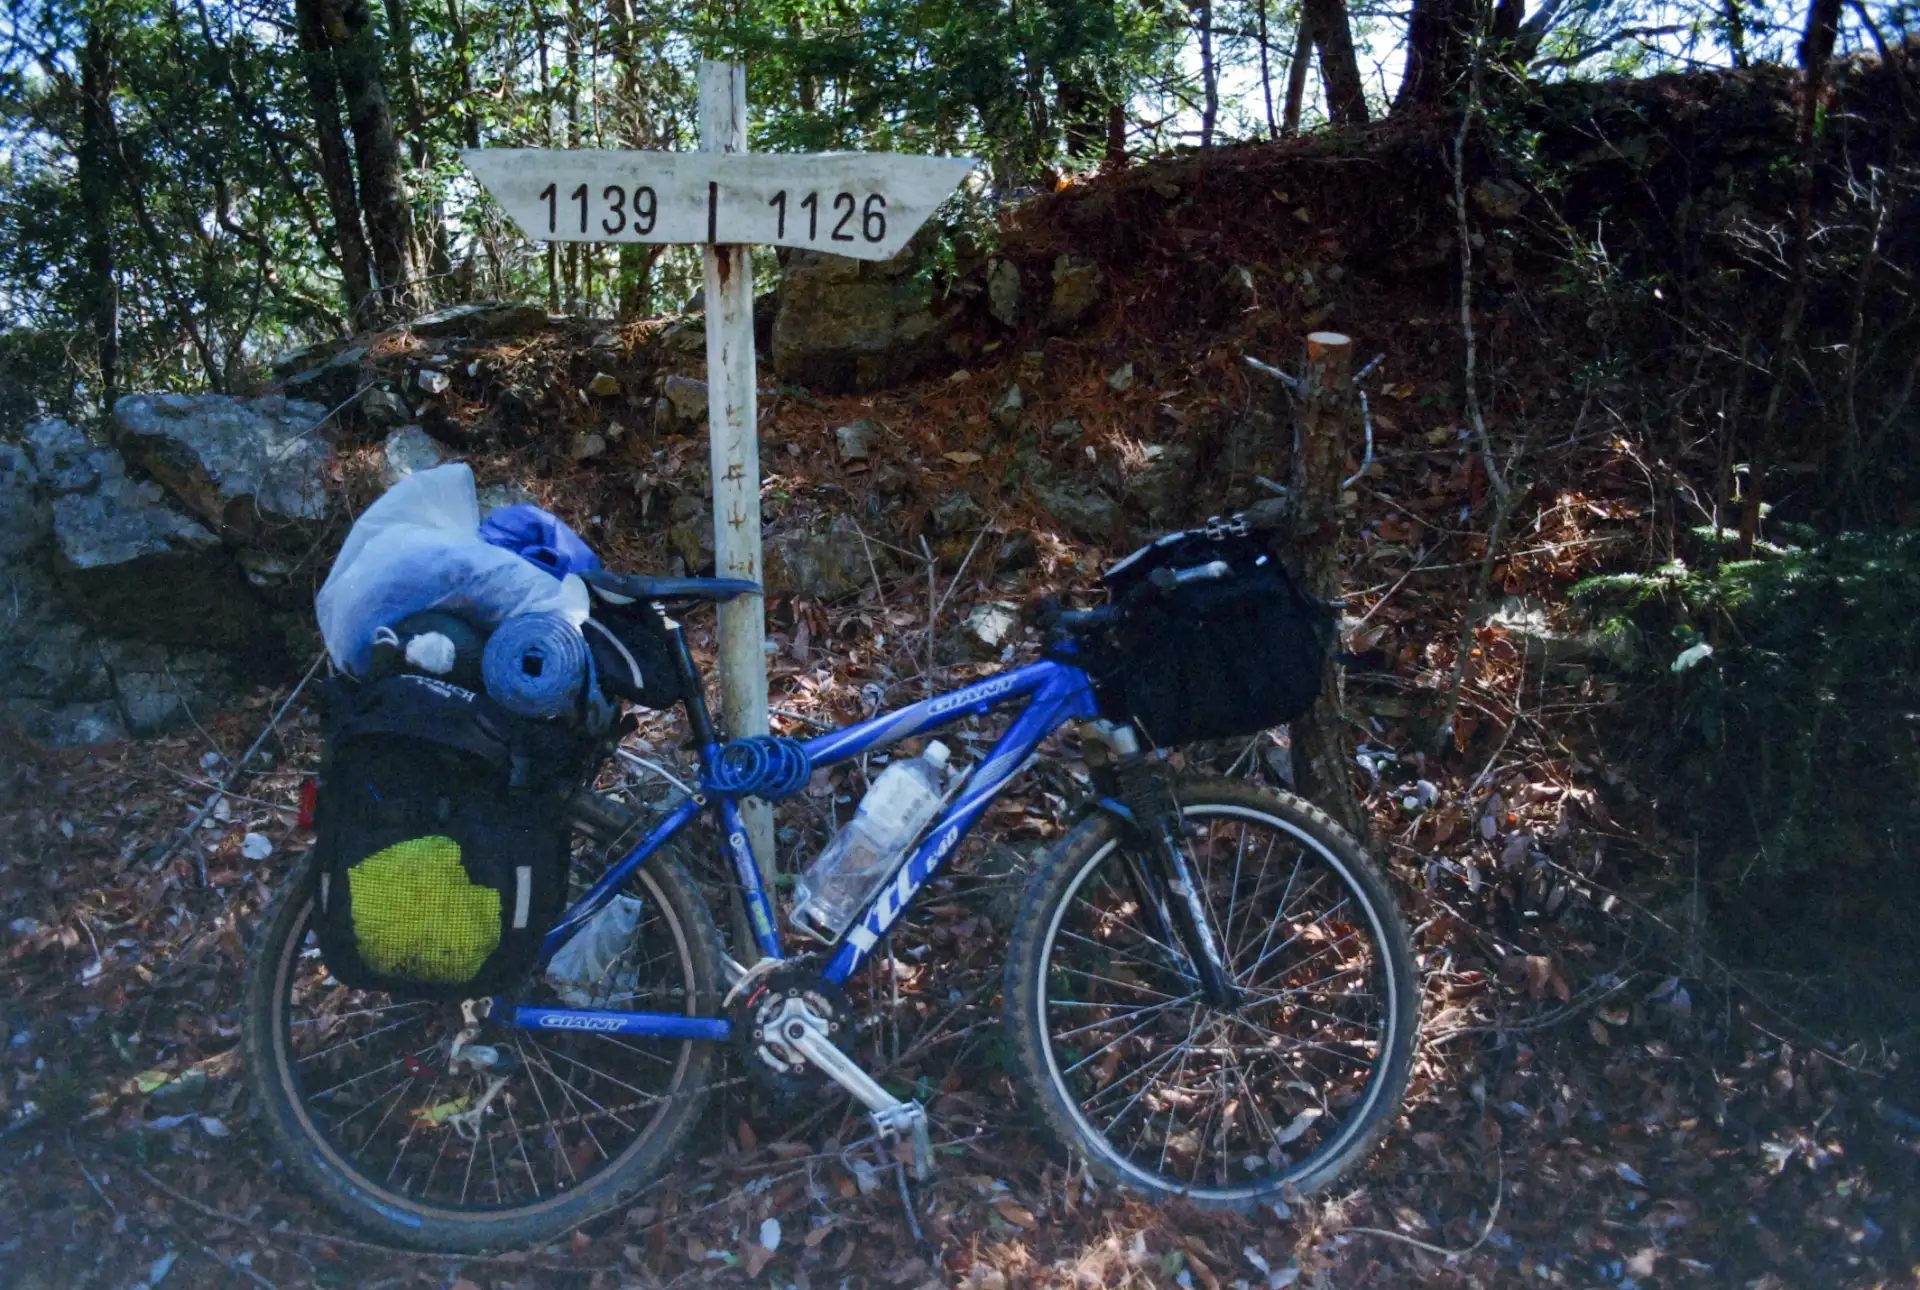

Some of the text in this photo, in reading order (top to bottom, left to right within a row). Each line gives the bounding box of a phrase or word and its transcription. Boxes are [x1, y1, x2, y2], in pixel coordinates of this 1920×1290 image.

[539, 182, 658, 236] 1139
[768, 189, 887, 243] 1126
[539, 1014, 629, 1031] GIANT
